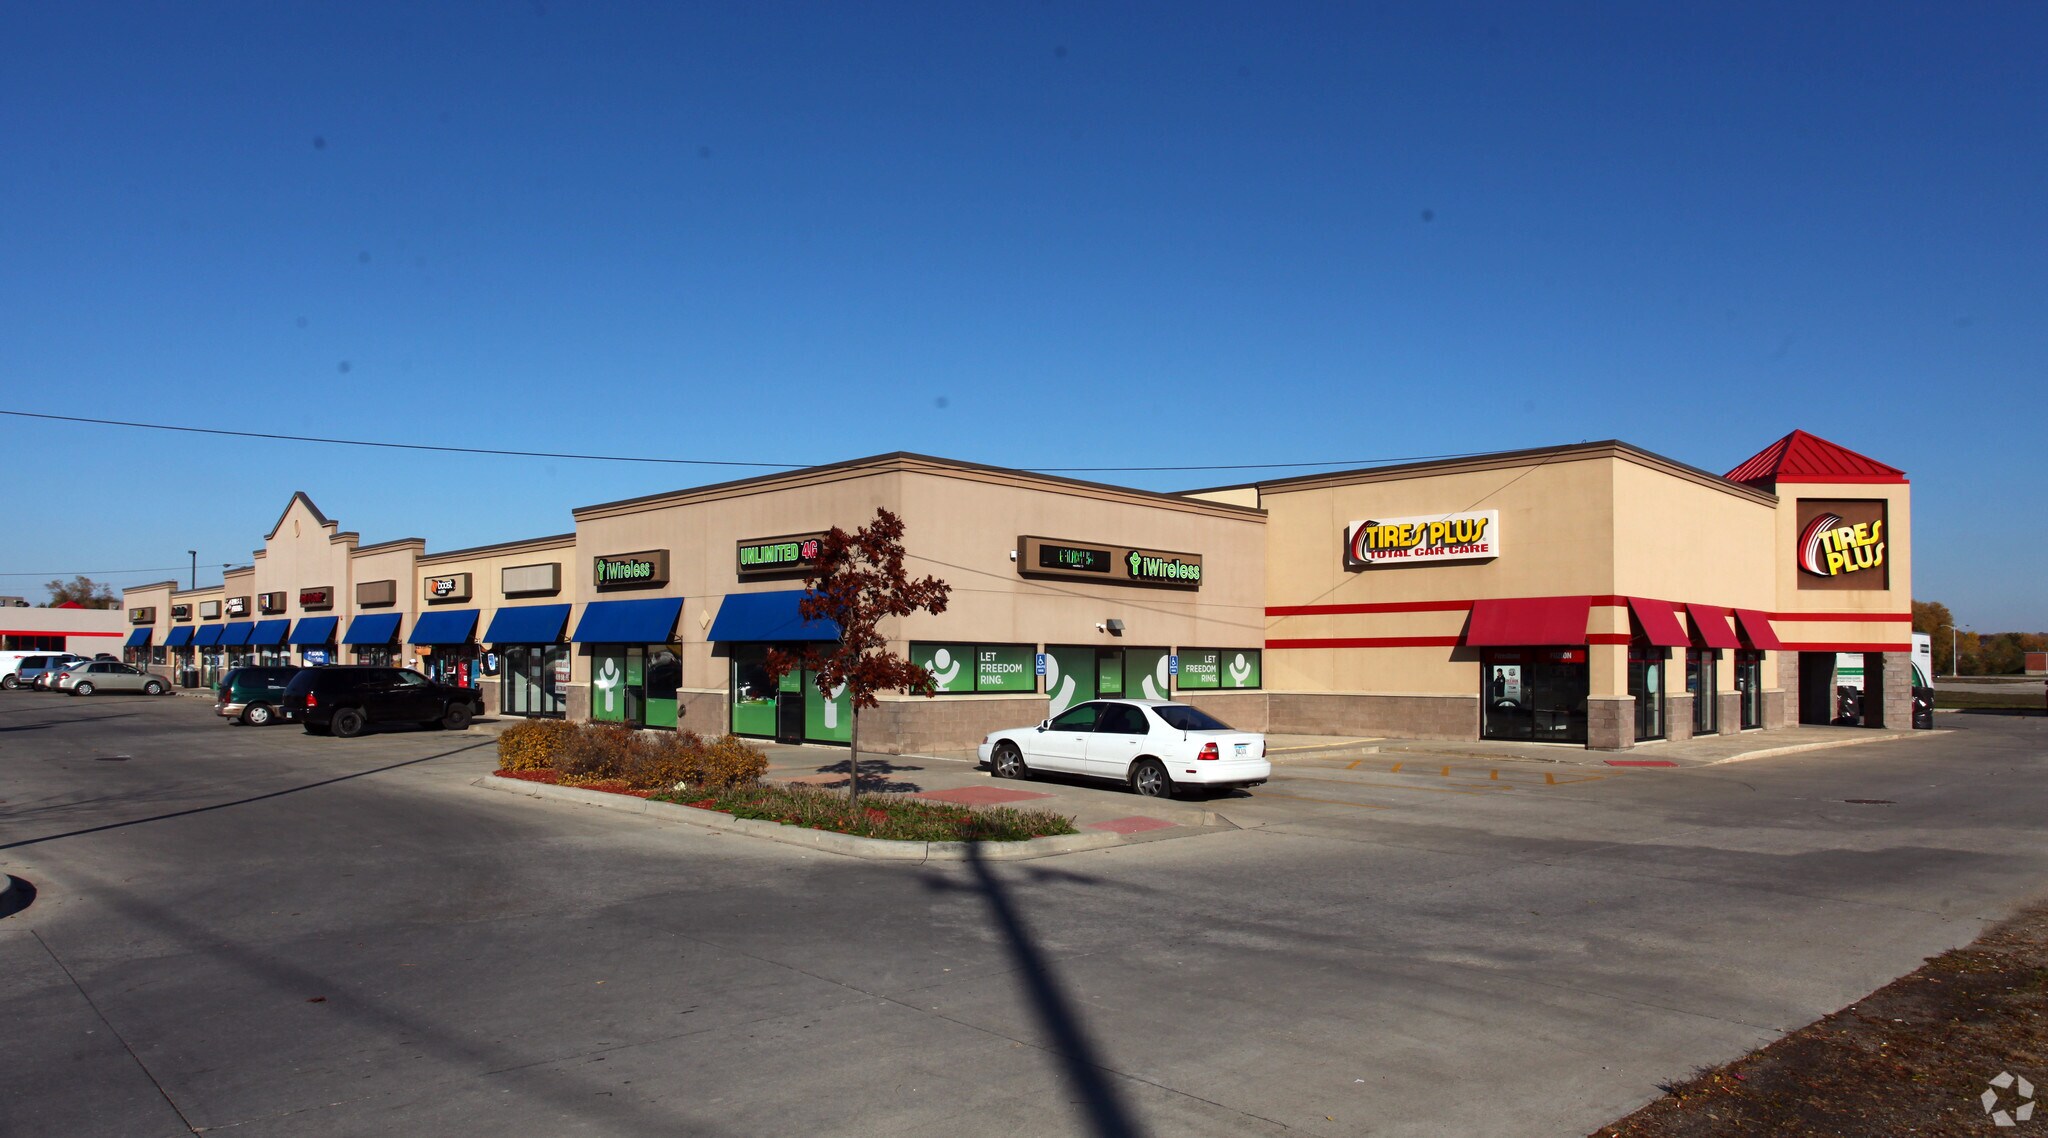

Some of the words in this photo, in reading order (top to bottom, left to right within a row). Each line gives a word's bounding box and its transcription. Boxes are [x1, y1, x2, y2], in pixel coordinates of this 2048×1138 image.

[1367, 522, 1427, 549] TIRES
[1430, 517, 1488, 545] PLUS
[1817, 520, 1882, 554] TIRES
[741, 543, 799, 565] UNLIMITED
[802, 540, 818, 559] 4G
[1370, 548, 1411, 559] TOTAL
[1414, 546, 1445, 557] CAR
[1449, 543, 1489, 554] CARE
[1827, 542, 1885, 576] PLUS
[606, 560, 650, 580] iWireless
[1143, 557, 1200, 580] iWireless
[437, 580, 453, 590] boost
[980, 652, 997, 662] LET
[1204, 655, 1217, 664] LET
[980, 663, 1023, 673] FREEDOM
[1185, 664, 1217, 673] FREEDOM
[980, 675, 1004, 685] RING.
[1201, 674, 1218, 683] RING.
